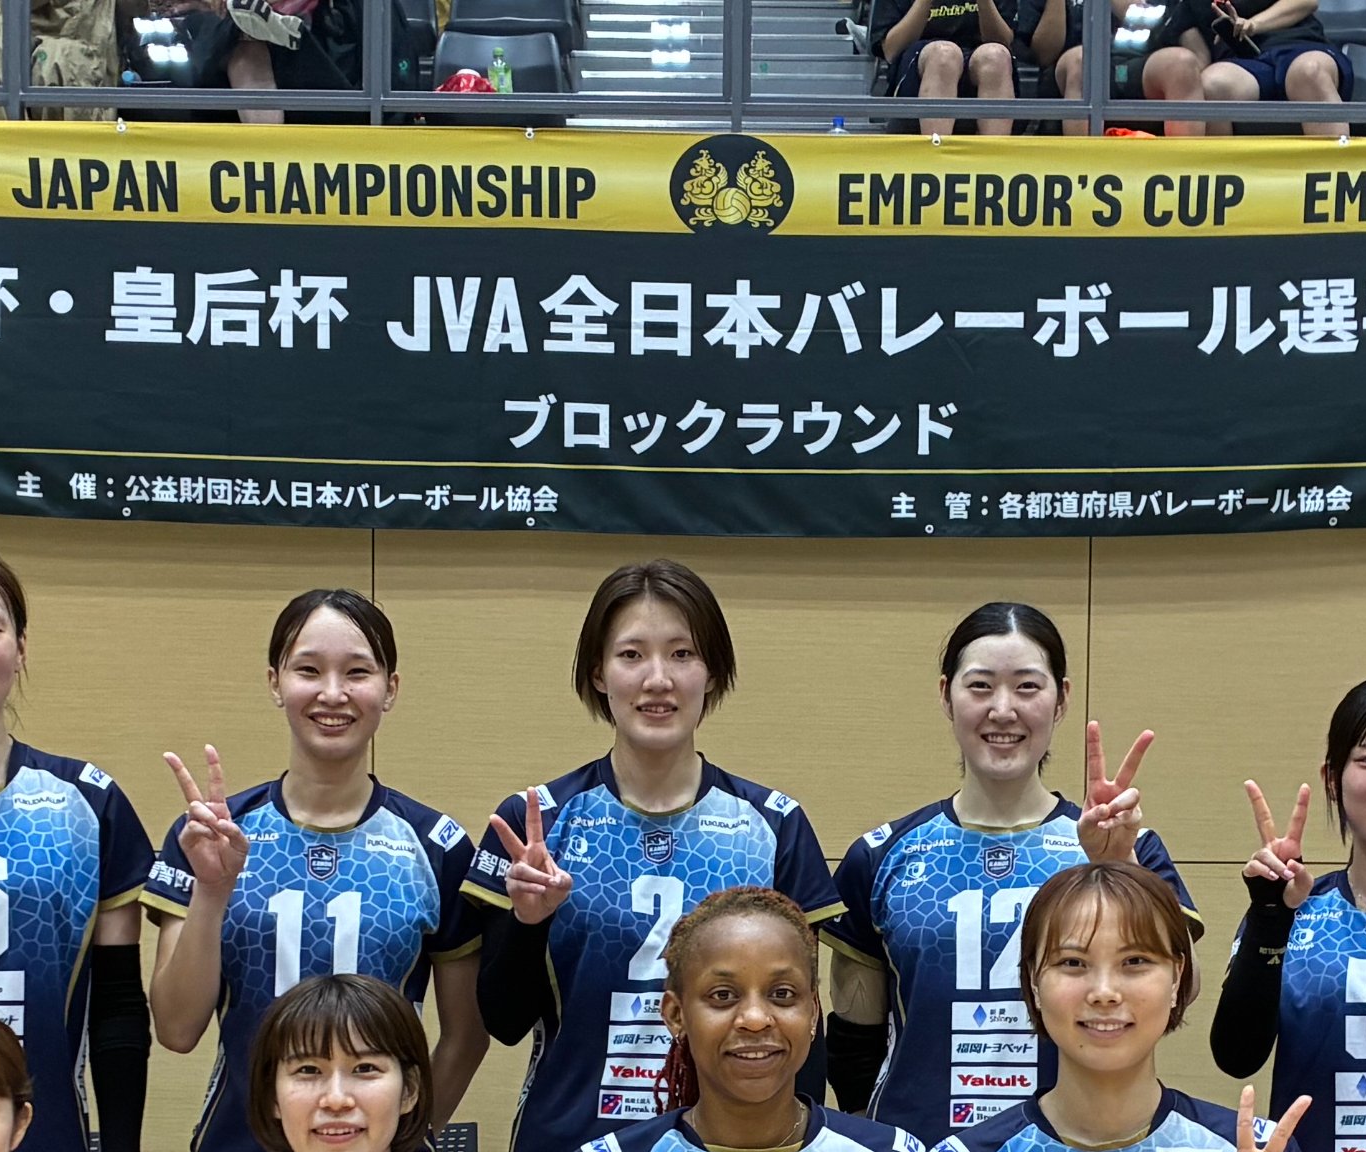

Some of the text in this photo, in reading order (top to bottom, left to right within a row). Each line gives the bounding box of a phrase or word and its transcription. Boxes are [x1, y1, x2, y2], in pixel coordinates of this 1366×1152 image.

[11, 157, 179, 213] JAPAN
[209, 160, 597, 220] CHAMPIONSHIP
[837, 173, 1246, 227] EMPEROR'S CUP
[504, 396, 959, 457] ブロックラウンド
[268, 889, 362, 997] 11
[628, 875, 684, 980] 2
[947, 887, 1039, 990] 12
[956, 1042, 1033, 1055] 福岡トヨペット
[989, 1014, 1019, 1024] Shinryo
[957, 1074, 1032, 1088] Yakult
